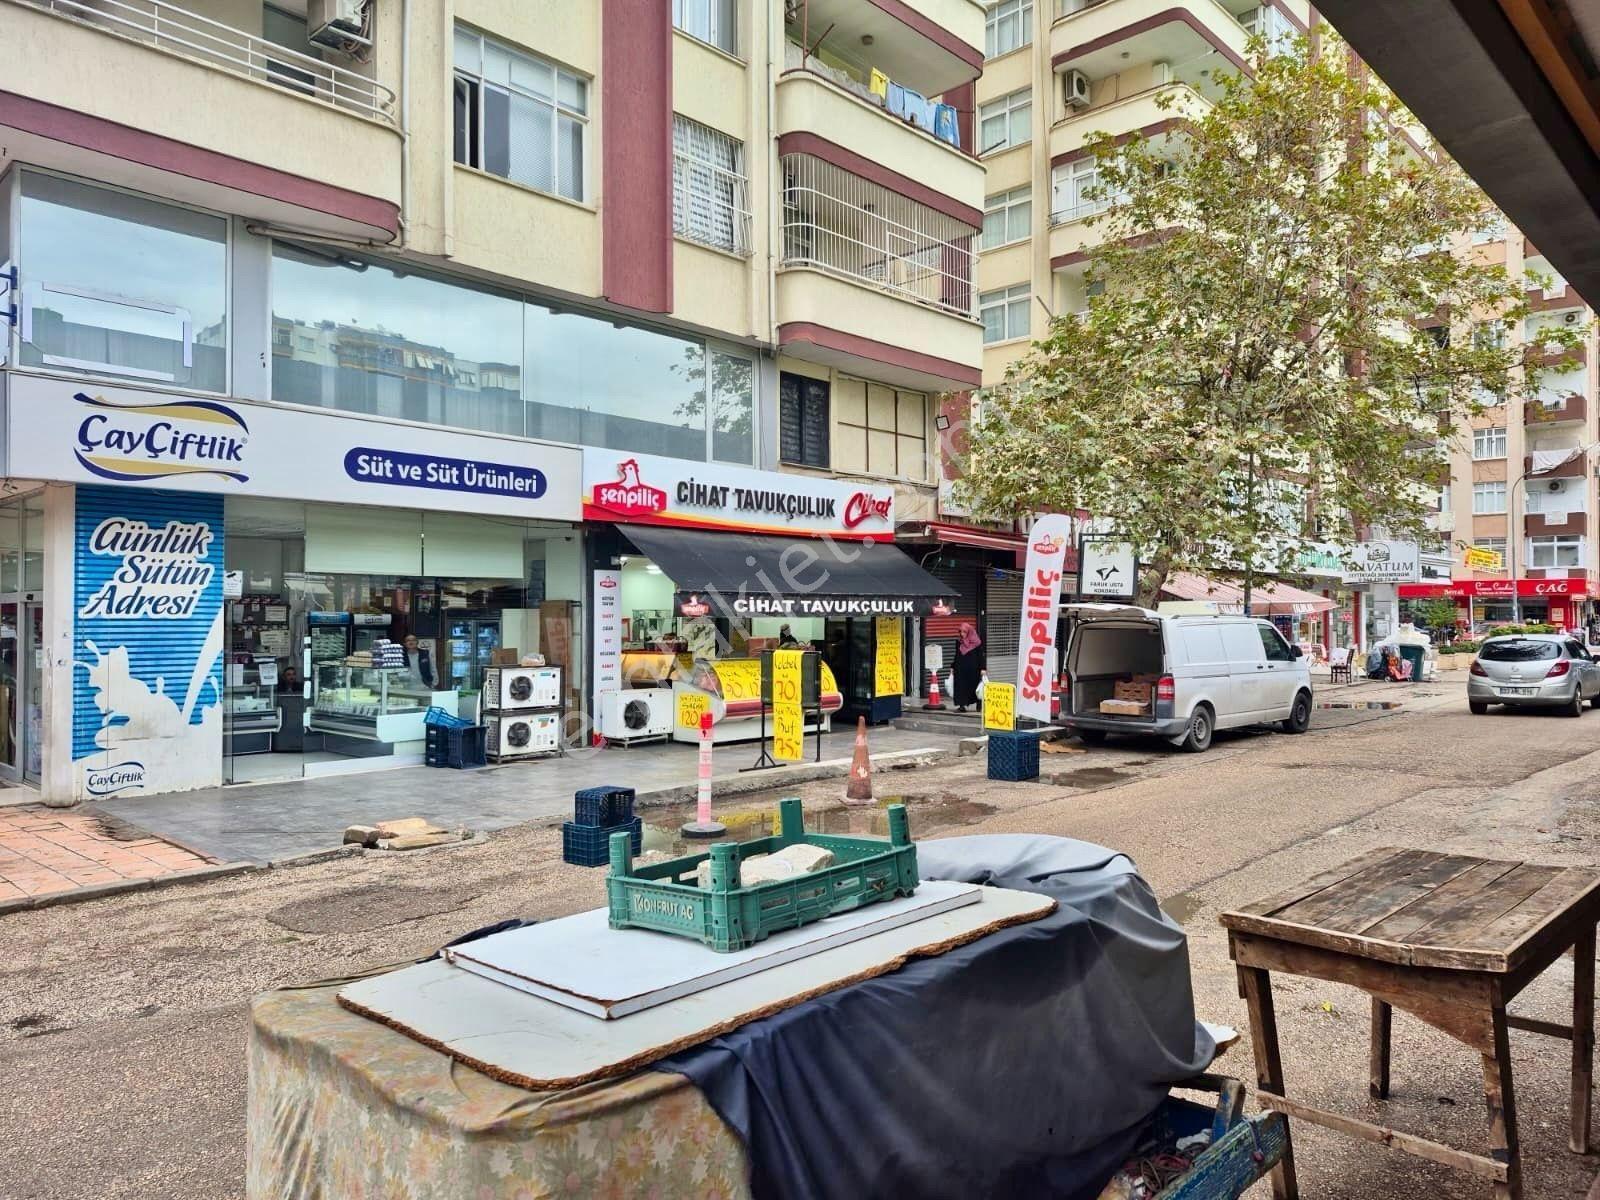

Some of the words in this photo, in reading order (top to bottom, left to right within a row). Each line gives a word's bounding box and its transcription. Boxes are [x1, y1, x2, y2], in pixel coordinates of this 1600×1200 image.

[77, 414, 244, 462] ÇayÇiftlik
[357, 454, 393, 478] Süt
[397, 464, 422, 481] ve
[426, 464, 460, 484] Süt
[463, 466, 537, 493] Ürünleri
[600, 487, 660, 511] şenpiliç
[676, 477, 730, 508] CİHAT
[733, 487, 836, 520] TAVUKÇULUK
[842, 491, 892, 529] Cihat
[94, 520, 210, 555] Günlük
[118, 555, 210, 586] Sütün
[83, 585, 198, 616] Adresi
[733, 596, 795, 613] CİHAT
[800, 599, 914, 616] TAVUKÇULUK
[1022, 568, 1061, 704] şenpiliç
